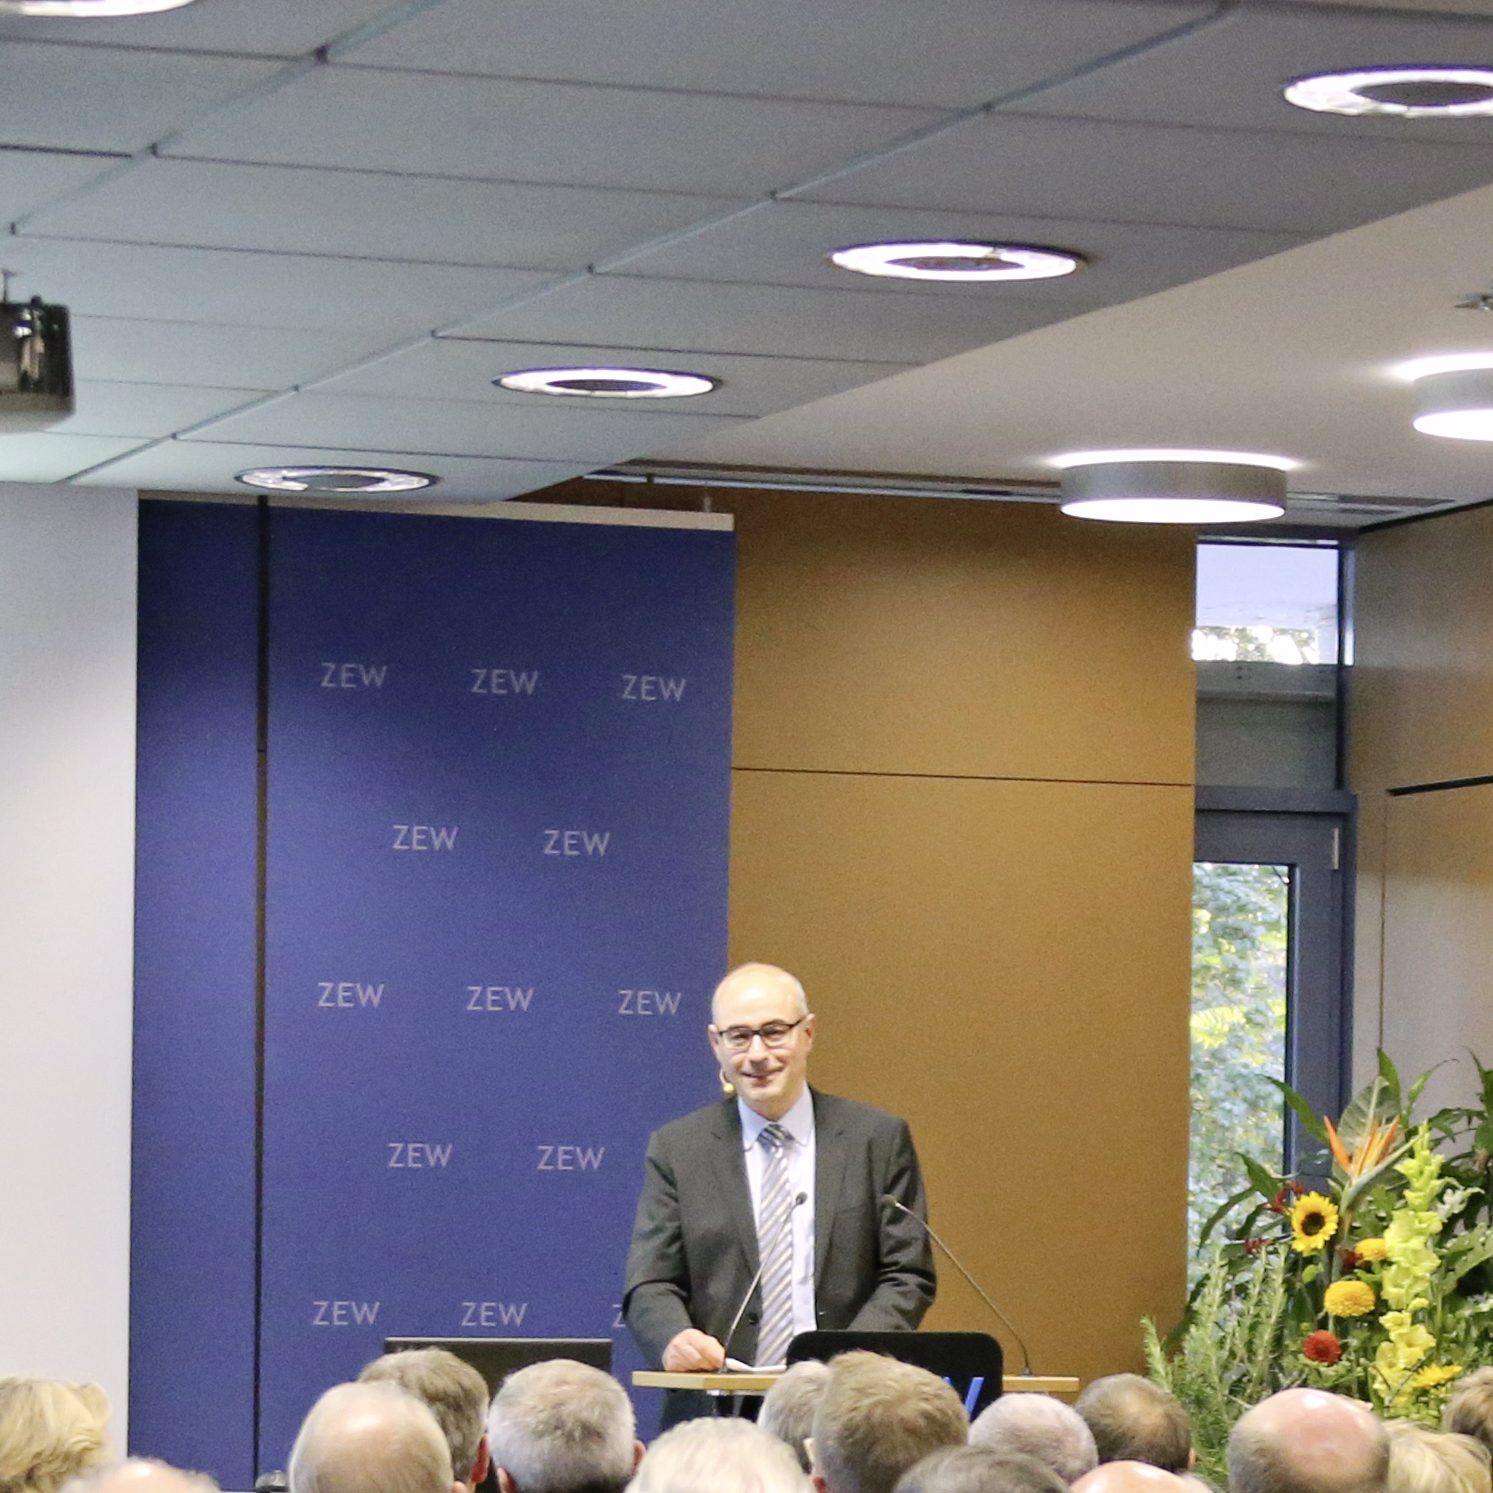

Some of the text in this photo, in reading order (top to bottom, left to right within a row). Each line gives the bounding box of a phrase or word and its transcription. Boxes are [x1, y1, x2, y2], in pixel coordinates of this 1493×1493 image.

[320, 662, 387, 689] ZEW
[470, 668, 538, 695] ZEW
[621, 674, 686, 702] ZEW
[392, 823, 458, 851] ZEW
[543, 829, 610, 856] ZEW
[317, 981, 384, 1008] ZEW
[466, 985, 533, 1012] ZEW
[617, 989, 681, 1016] ZEW
[387, 1142, 452, 1169] ZEW
[536, 1145, 604, 1171] ZEW
[312, 1300, 379, 1327] ZEW
[460, 1302, 527, 1328] ZEW
